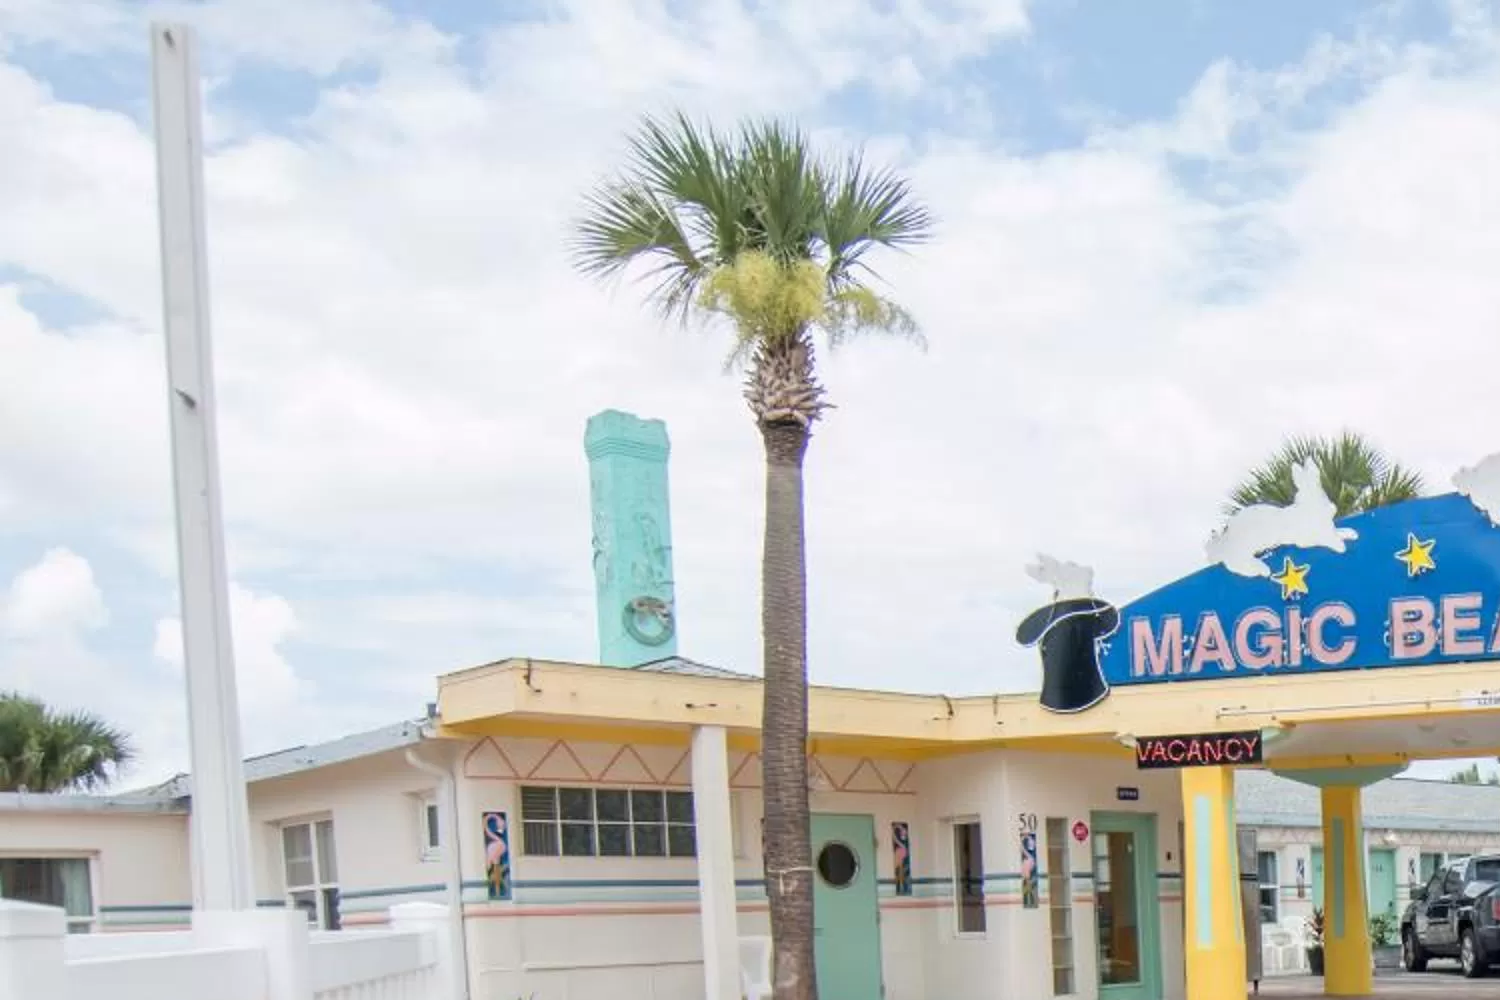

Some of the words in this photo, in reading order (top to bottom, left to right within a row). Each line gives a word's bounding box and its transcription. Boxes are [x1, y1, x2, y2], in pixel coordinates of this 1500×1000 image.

[1128, 602, 1358, 677] MAGIC
[1136, 737, 1258, 763] VACANCY
[1018, 813, 1037, 832] 50
